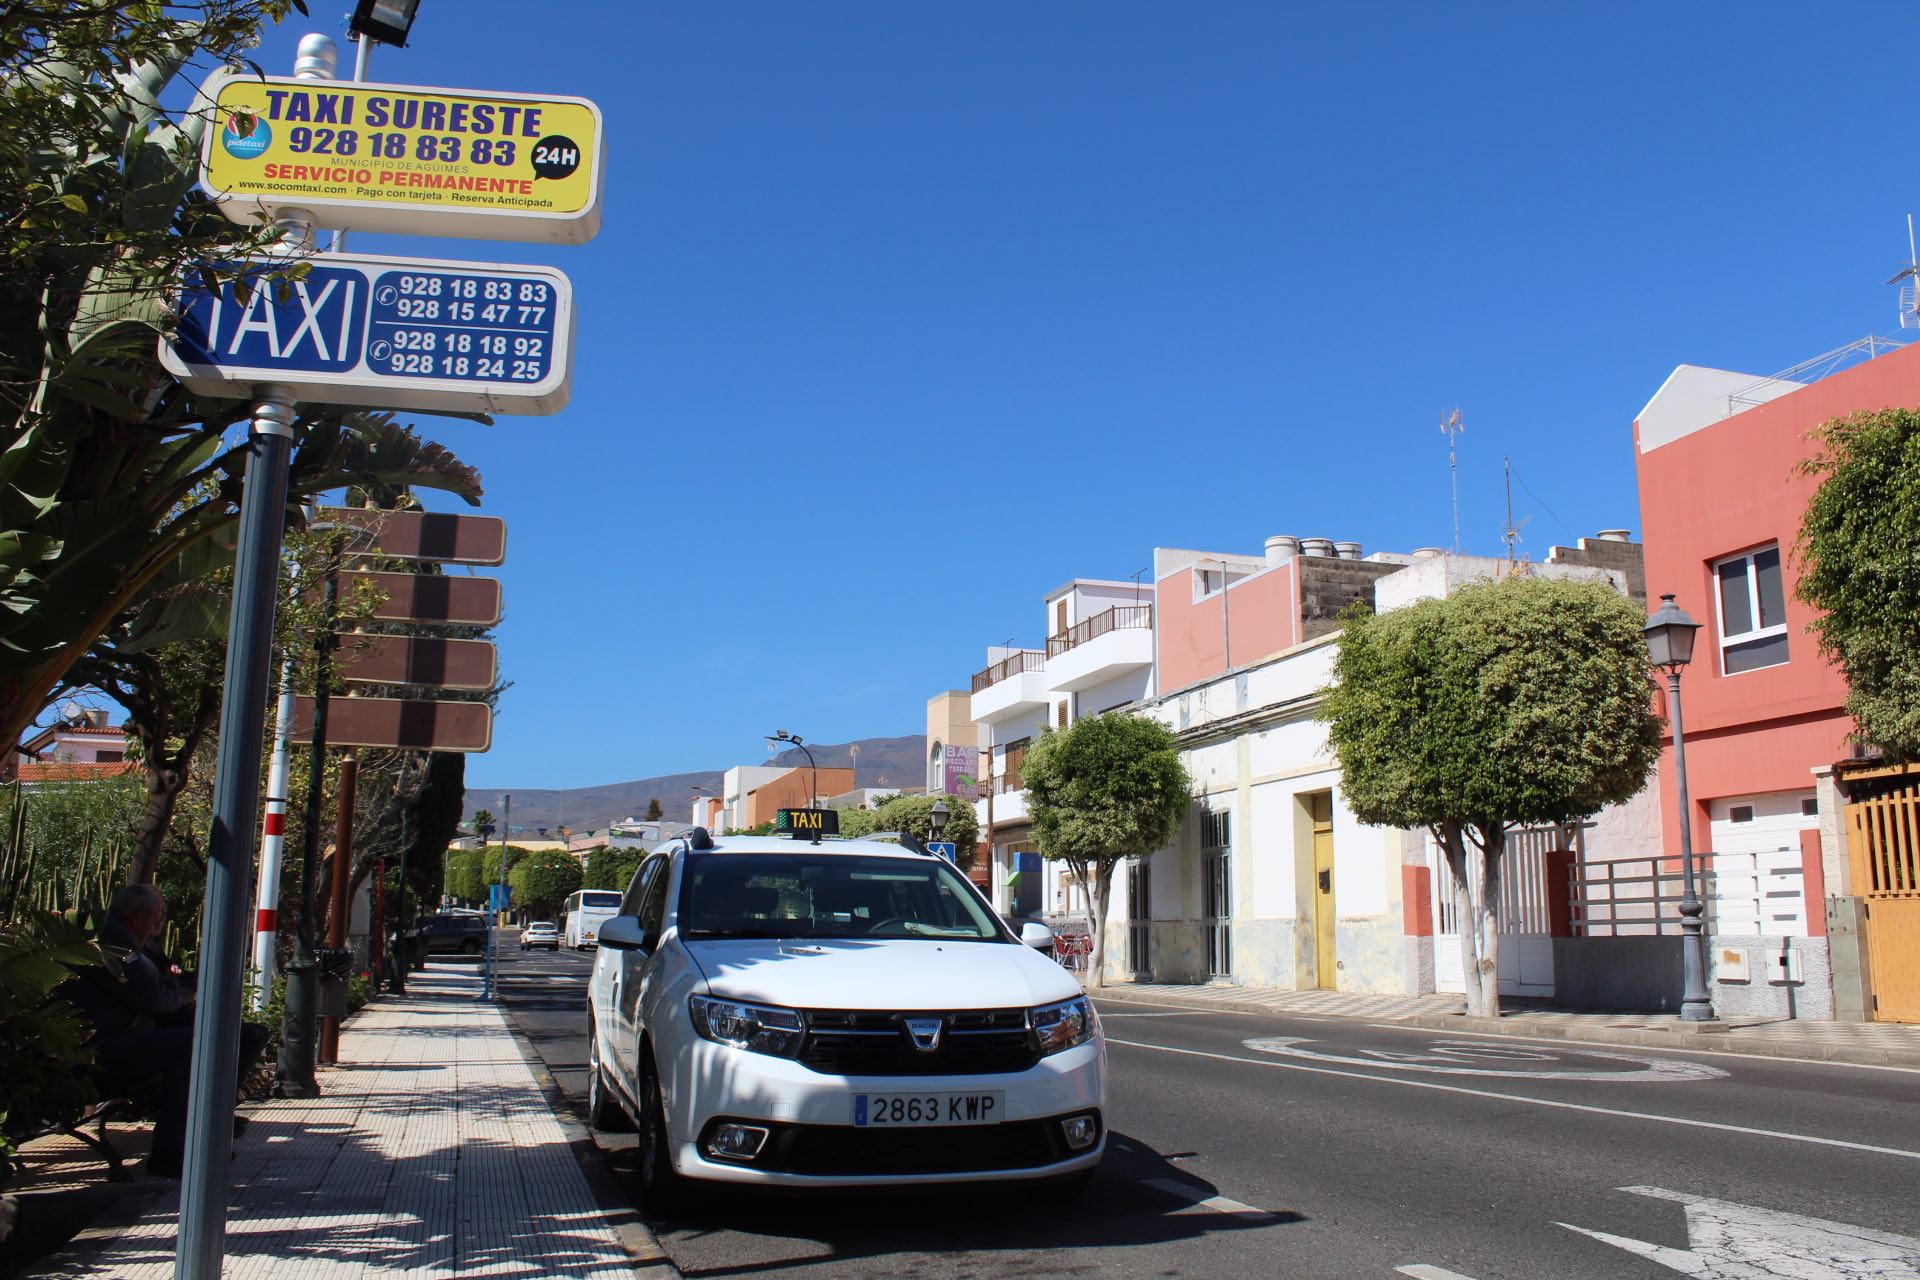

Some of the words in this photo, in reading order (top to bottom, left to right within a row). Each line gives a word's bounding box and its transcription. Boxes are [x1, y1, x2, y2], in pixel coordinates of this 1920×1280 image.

[266, 90, 355, 125] TAXI
[365, 97, 542, 138] SURESTE
[289, 126, 358, 156] 928
[368, 132, 407, 159] 18
[415, 135, 462, 163] 83
[470, 138, 516, 167] 83
[535, 146, 577, 166] 24H
[331, 157, 394, 170] MUNICIPIO
[397, 161, 412, 170] DE
[415, 161, 469, 174] AGÜIMES
[264, 163, 372, 185] SERVICIO
[379, 171, 533, 195] PERMANENTE
[239, 181, 347, 194] www.socomtaxi.com
[356, 186, 383, 198] Pago
[386, 189, 406, 198] con
[409, 189, 442, 201] tarjeta
[451, 193, 494, 204] Reserva
[498, 196, 553, 208] Anticipada
[399, 276, 442, 296] 928
[450, 279, 477, 299] 18
[484, 281, 512, 301] 83
[519, 283, 547, 303] 83
[397, 299, 440, 319] 928
[448, 301, 475, 321] 15
[481, 303, 511, 323] 47
[518, 306, 546, 325] 77
[394, 331, 436, 351] 928
[444, 333, 472, 353] 18
[480, 335, 507, 355] 18
[514, 338, 543, 357] 92
[391, 354, 434, 374] 928
[441, 356, 469, 376] 18
[475, 358, 505, 378] 24
[511, 361, 540, 380] 25
[946, 746, 978, 759] BAR
[790, 811, 822, 829] TAXI
[873, 1097, 939, 1123] 2863
[949, 1096, 995, 1121] KWP
